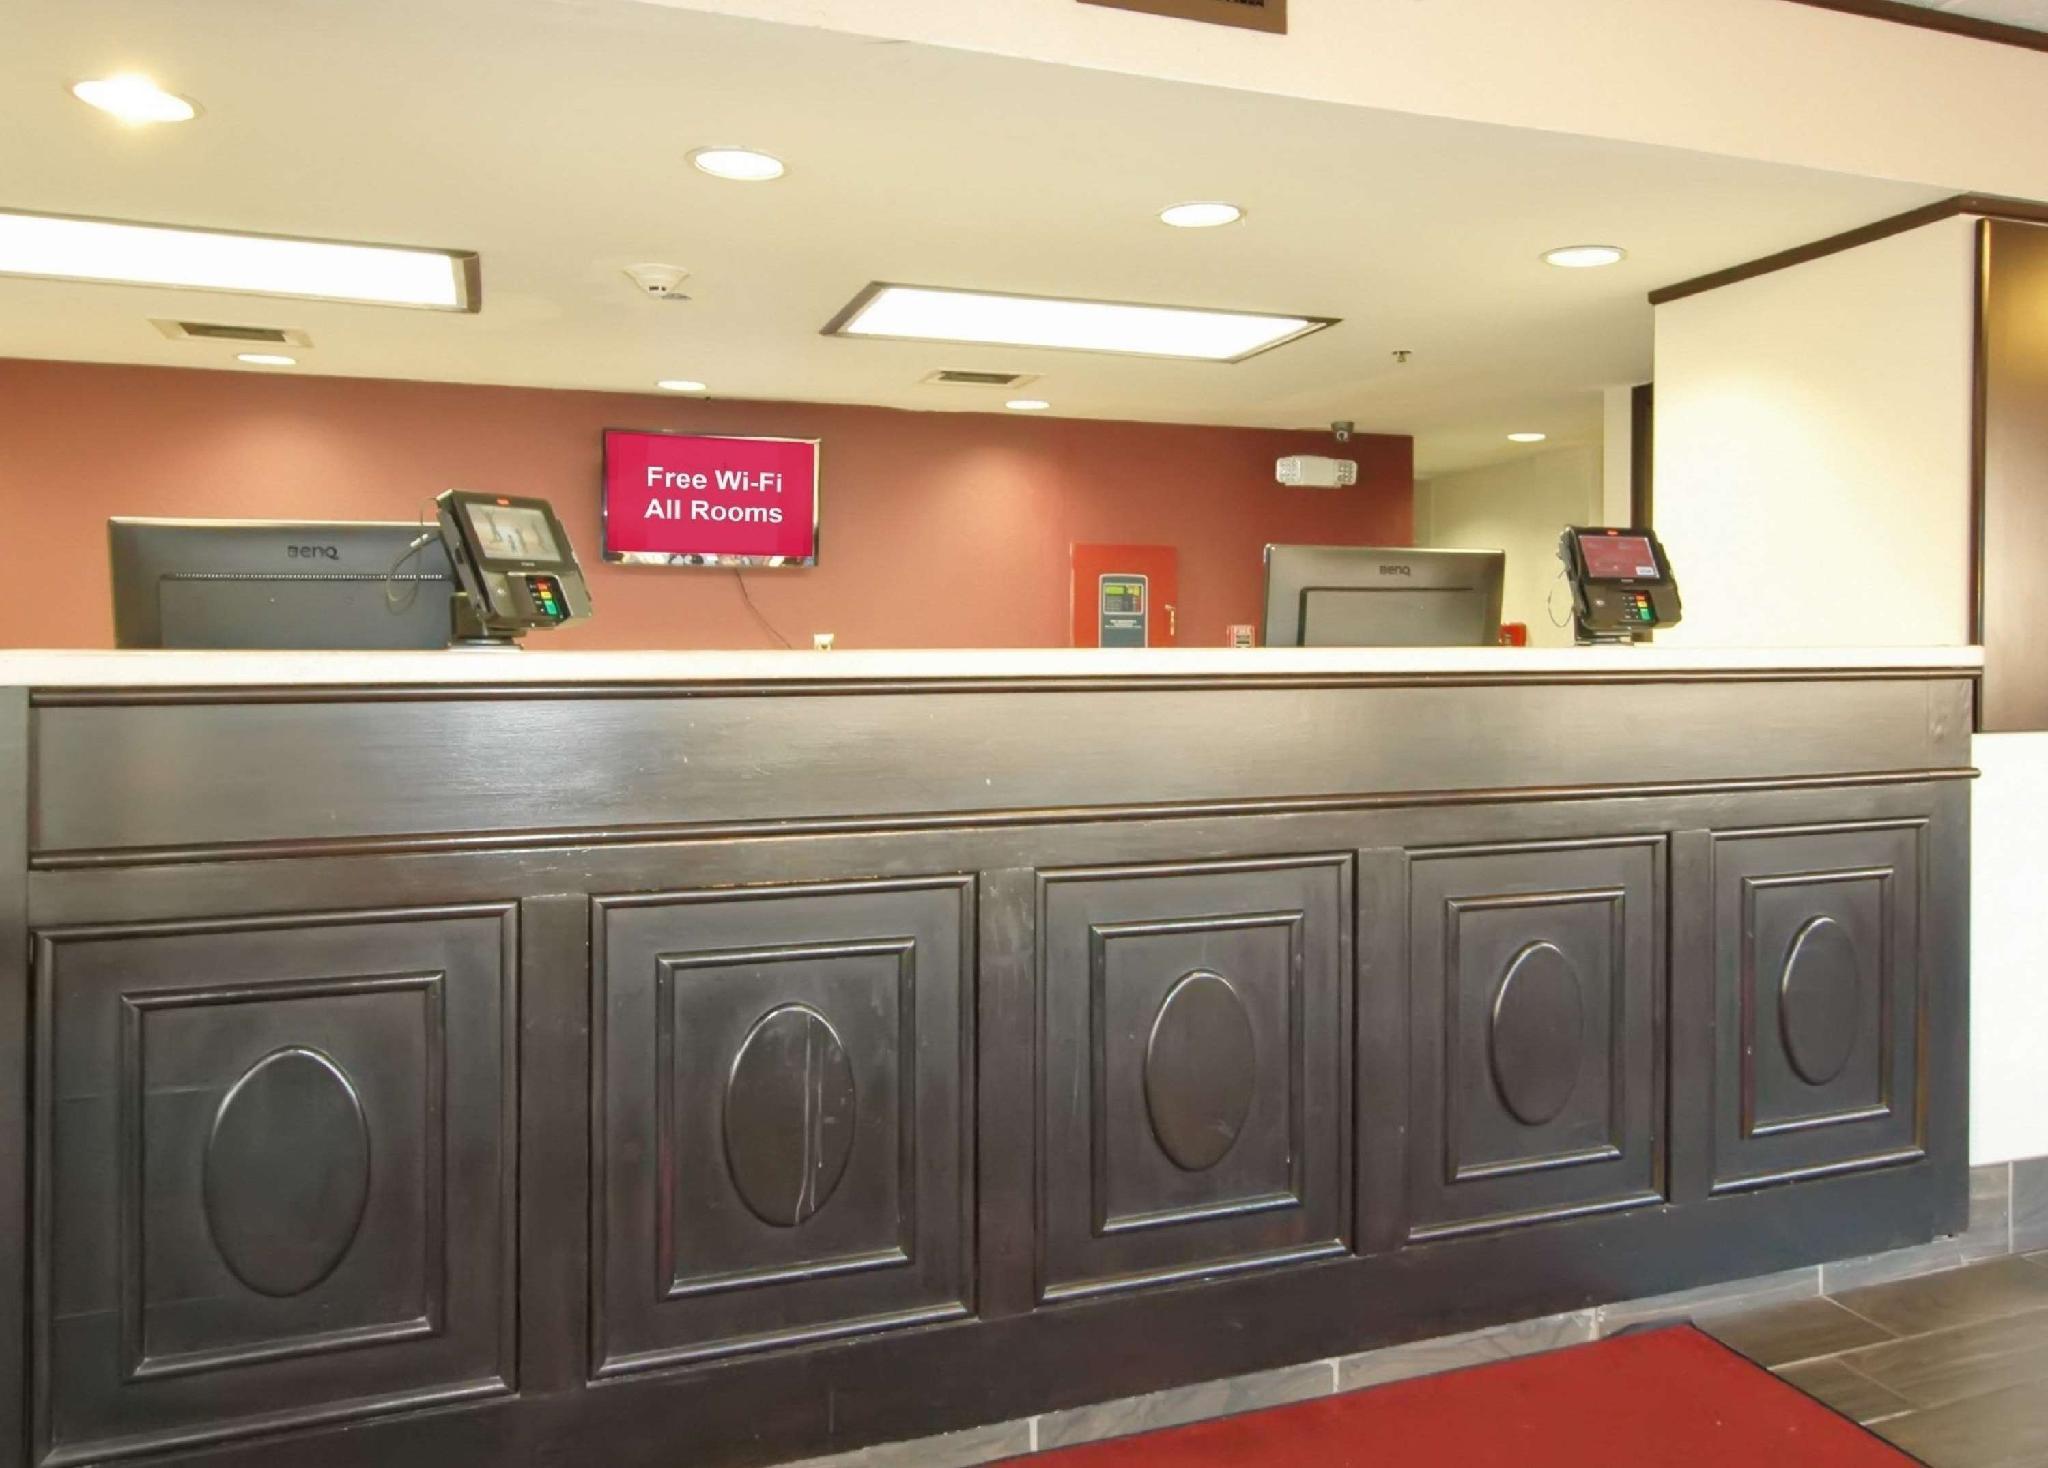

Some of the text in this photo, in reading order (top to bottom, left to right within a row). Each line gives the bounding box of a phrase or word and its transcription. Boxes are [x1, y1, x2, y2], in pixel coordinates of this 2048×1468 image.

[646, 466, 783, 493] Free Wi-Fi
[643, 498, 783, 524] All Rooms
